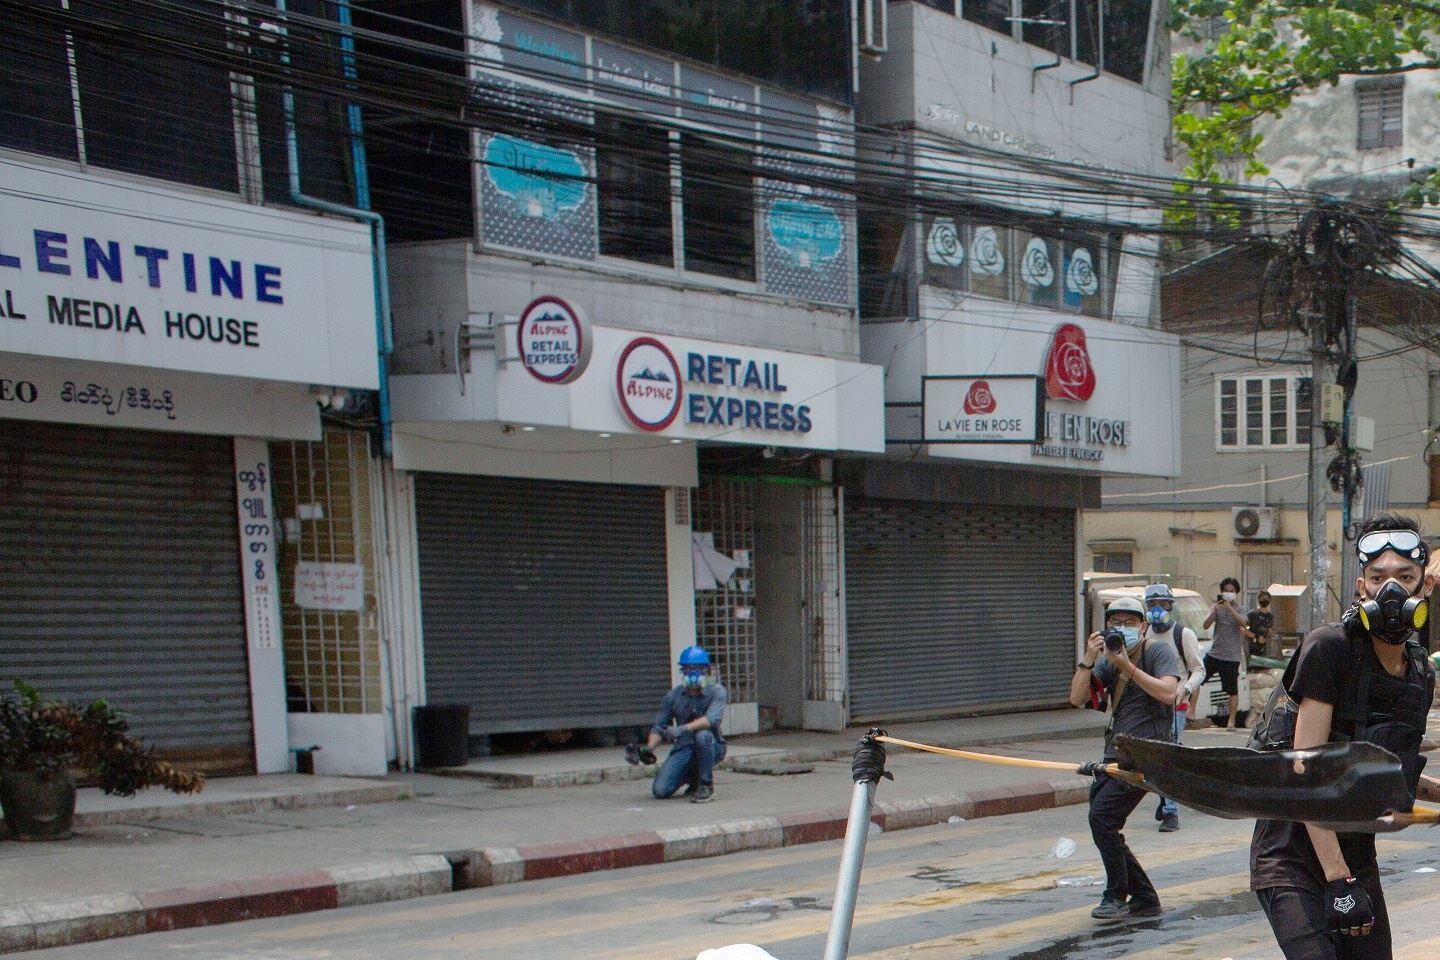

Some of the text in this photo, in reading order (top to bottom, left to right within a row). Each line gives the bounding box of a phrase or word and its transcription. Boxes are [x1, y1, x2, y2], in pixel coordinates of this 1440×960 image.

[47, 294, 146, 335] MEDIA
[165, 310, 260, 348] HOUSE
[526, 352, 577, 365] EXPRESS
[531, 340, 572, 352] RETAIL
[687, 351, 788, 393] RETAIL
[626, 380, 674, 401] ALPINE
[688, 393, 812, 434] EXPRESS
[938, 418, 1022, 432] LA VIE EN ROSE
[1061, 413, 1080, 441] EN
[1085, 416, 1131, 447] ROSE
